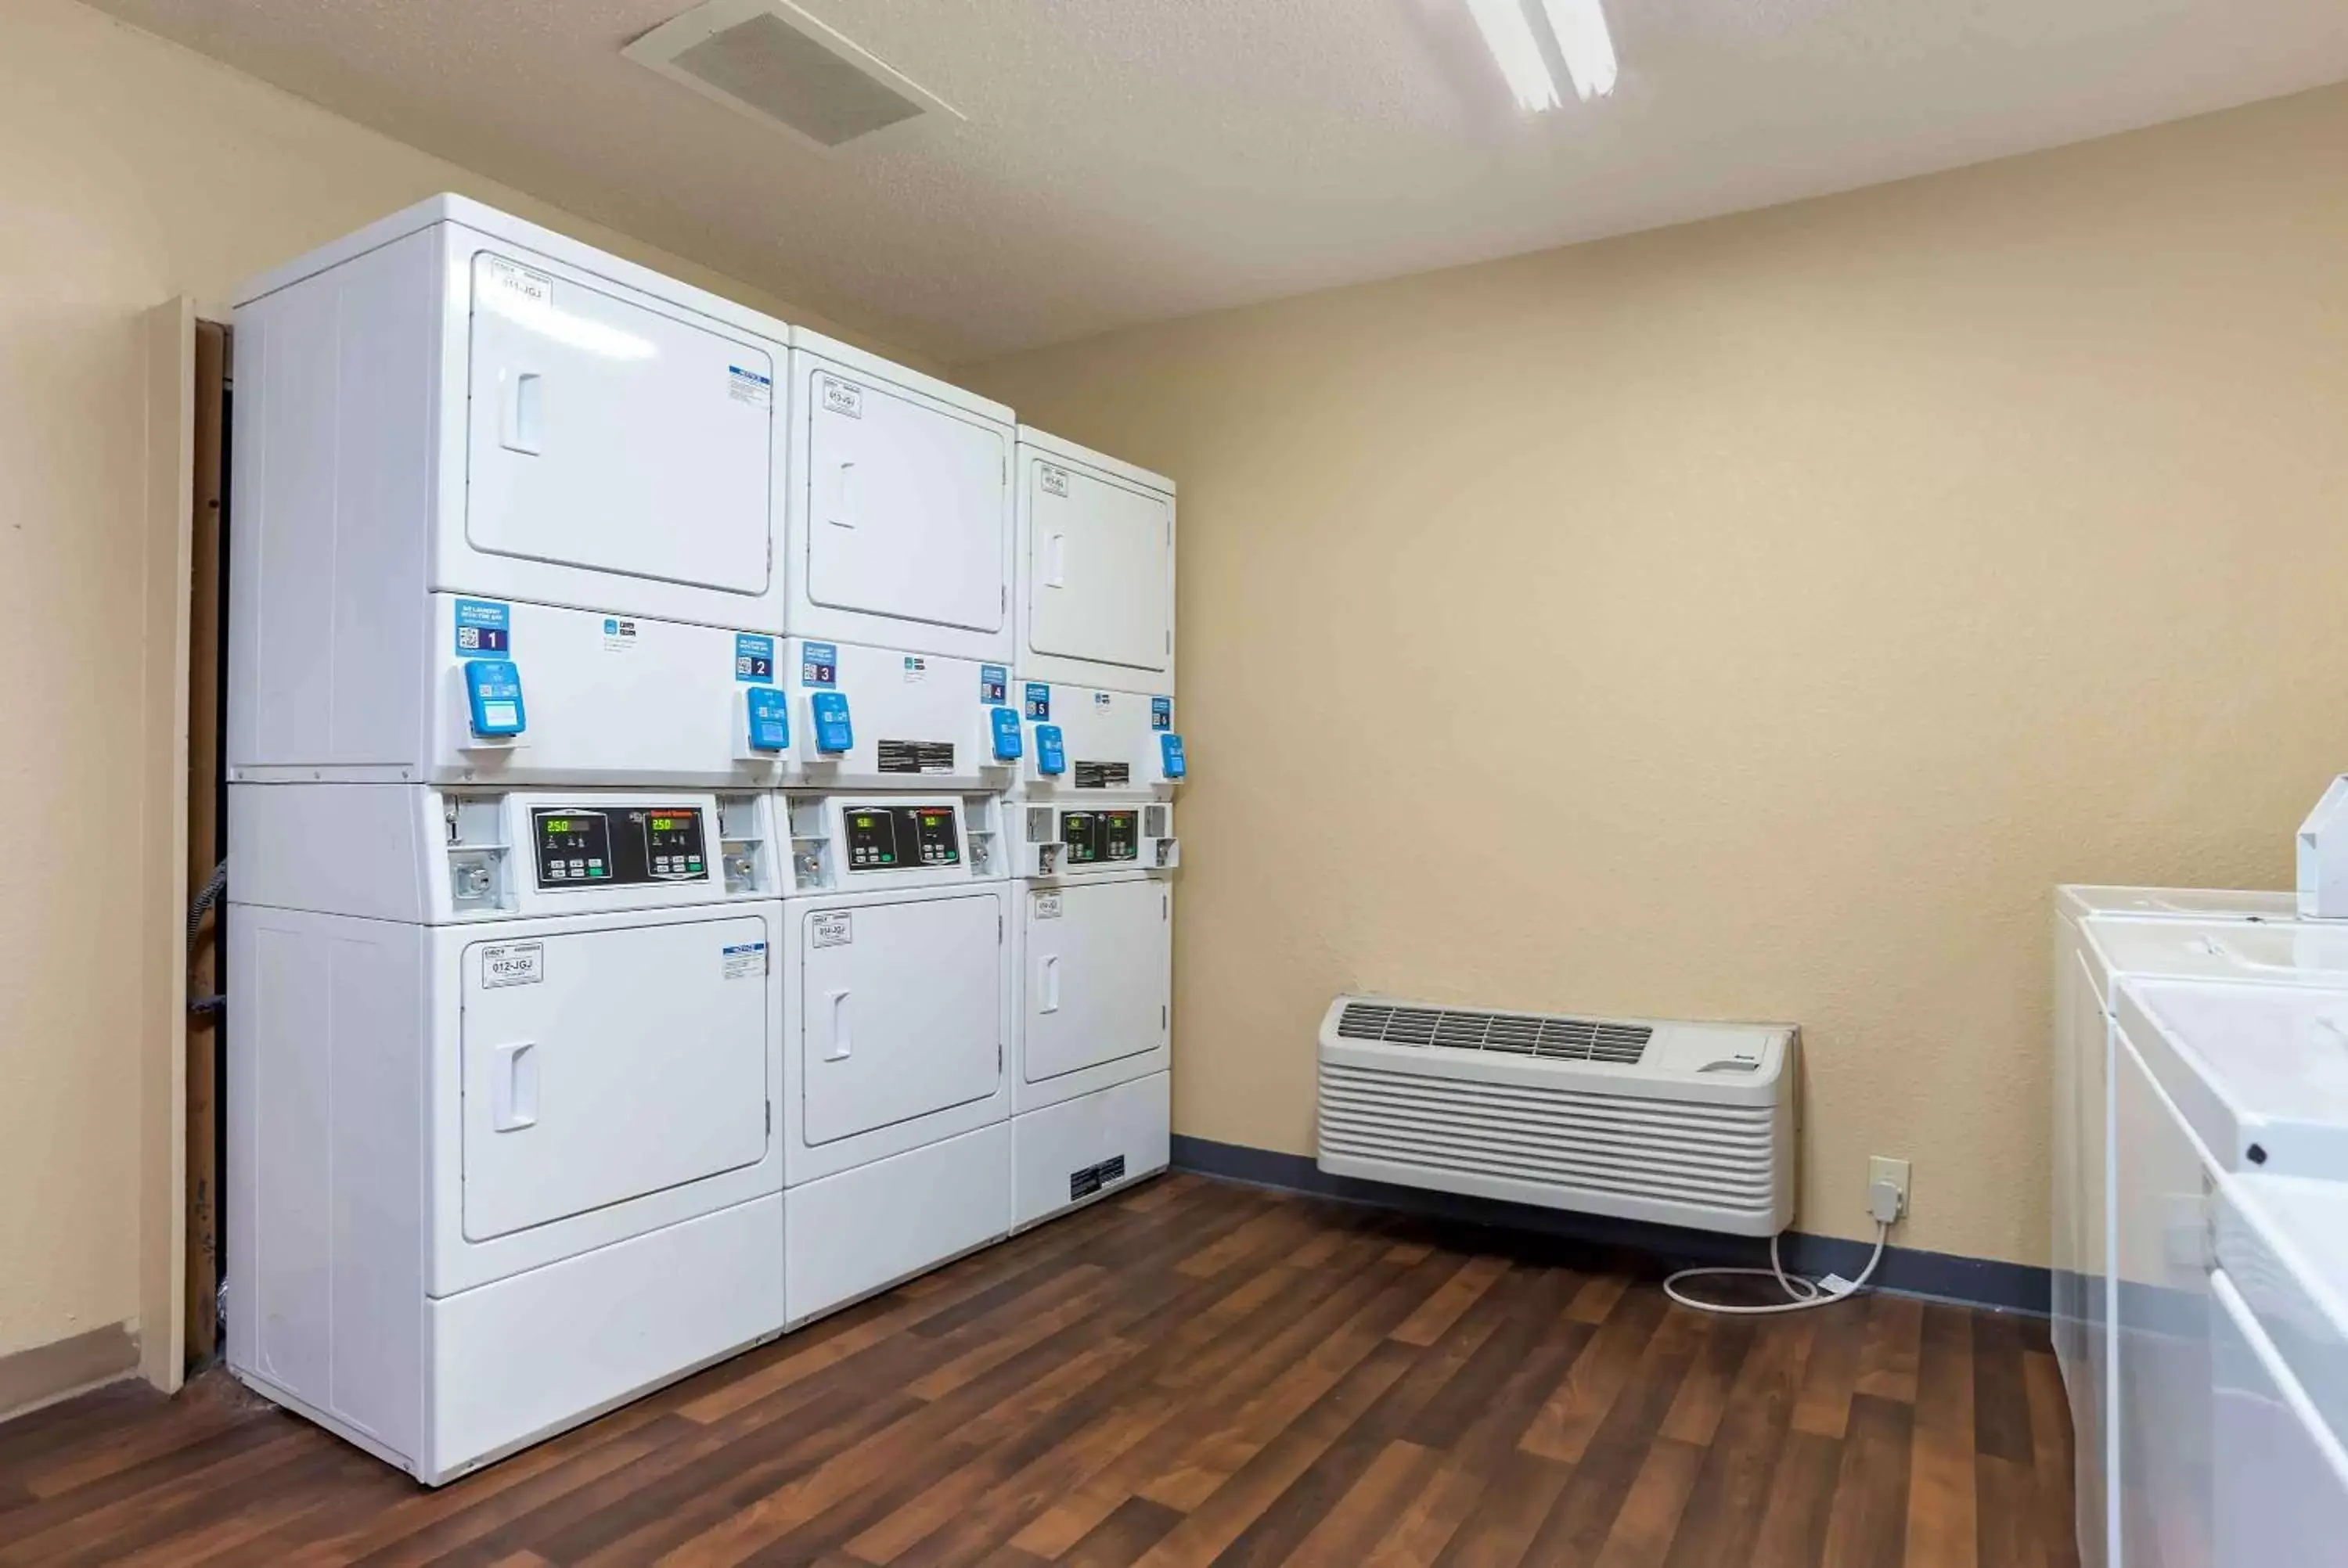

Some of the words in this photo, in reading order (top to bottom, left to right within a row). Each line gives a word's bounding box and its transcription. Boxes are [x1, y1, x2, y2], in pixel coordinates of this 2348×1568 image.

[488, 631, 496, 648] 1
[757, 661, 765, 674] 2
[822, 667, 829, 680] 3
[995, 687, 1001, 698] 4
[1039, 703, 1045, 714] 5
